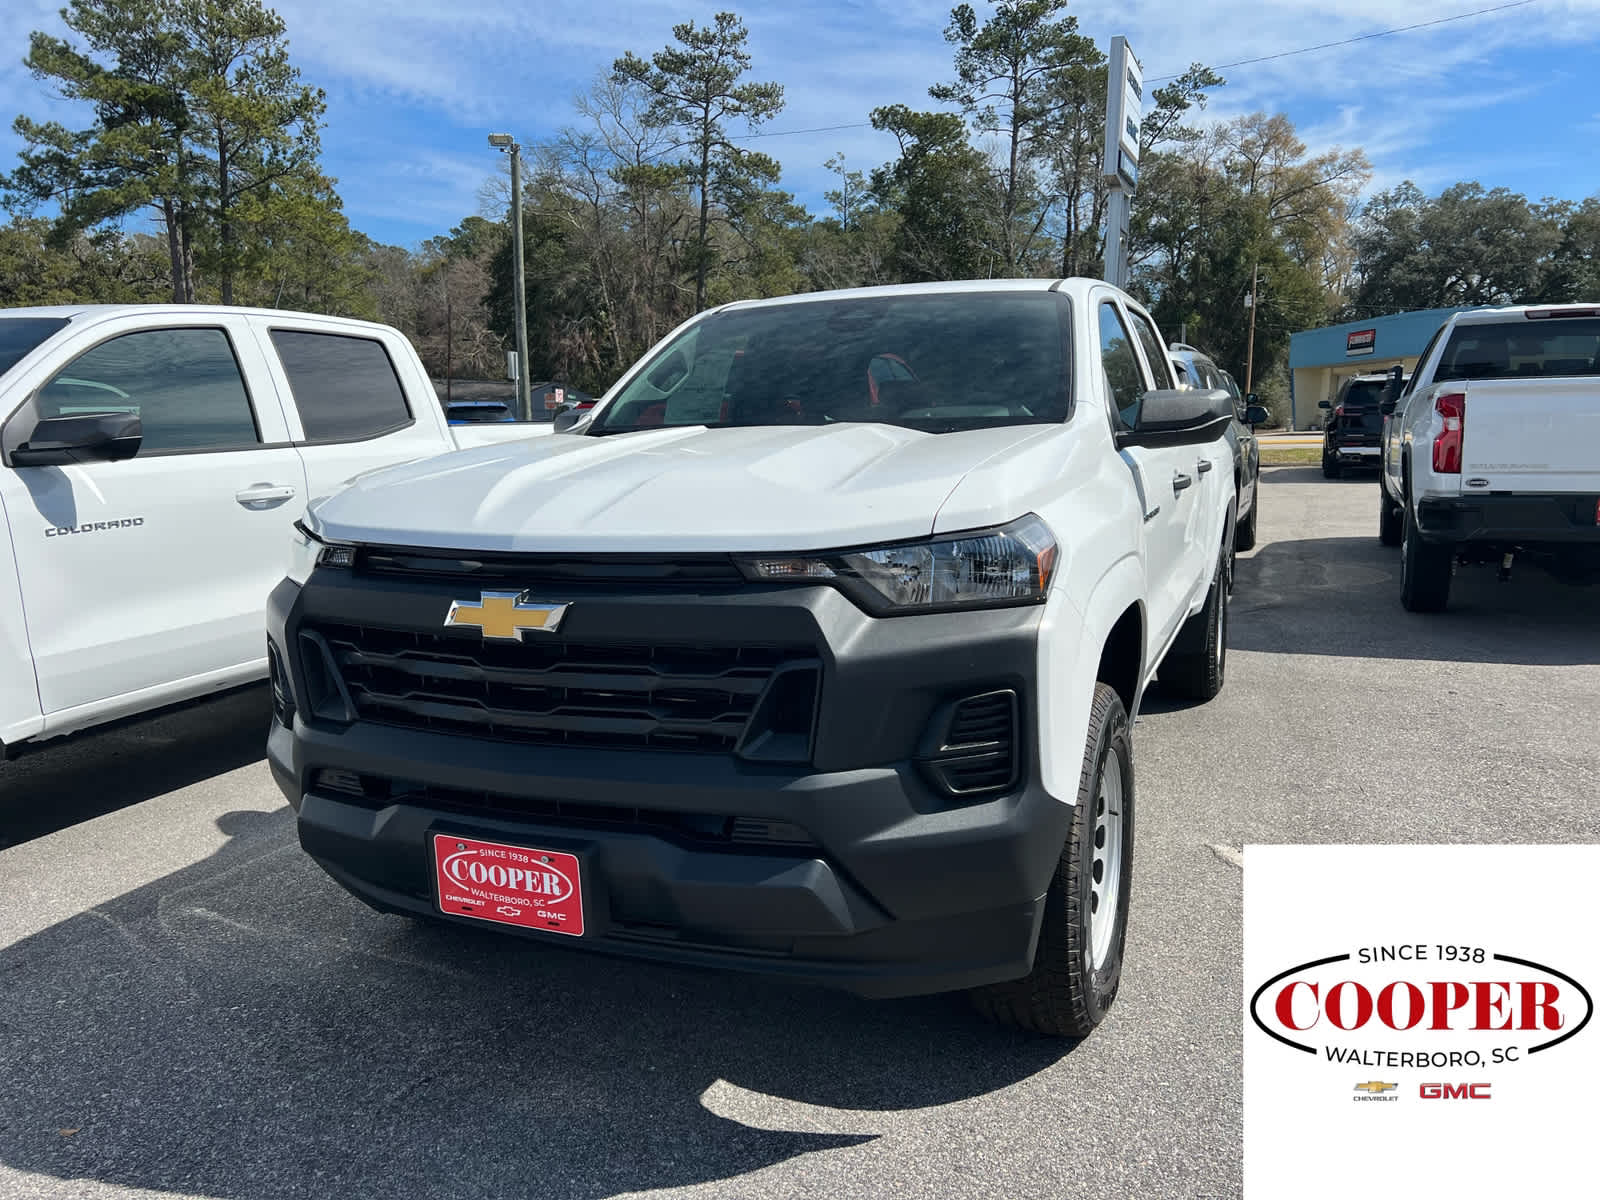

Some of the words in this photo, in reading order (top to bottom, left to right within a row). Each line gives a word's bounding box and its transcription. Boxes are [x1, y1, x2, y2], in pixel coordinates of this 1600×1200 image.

[45, 517, 144, 537] COLORADO
[479, 849, 506, 859] SINCE
[508, 852, 529, 863] 1938
[451, 858, 561, 896] COOPER
[470, 887, 532, 907] WALTERBORO,
[533, 898, 545, 907] SC
[537, 910, 567, 921] GMC
